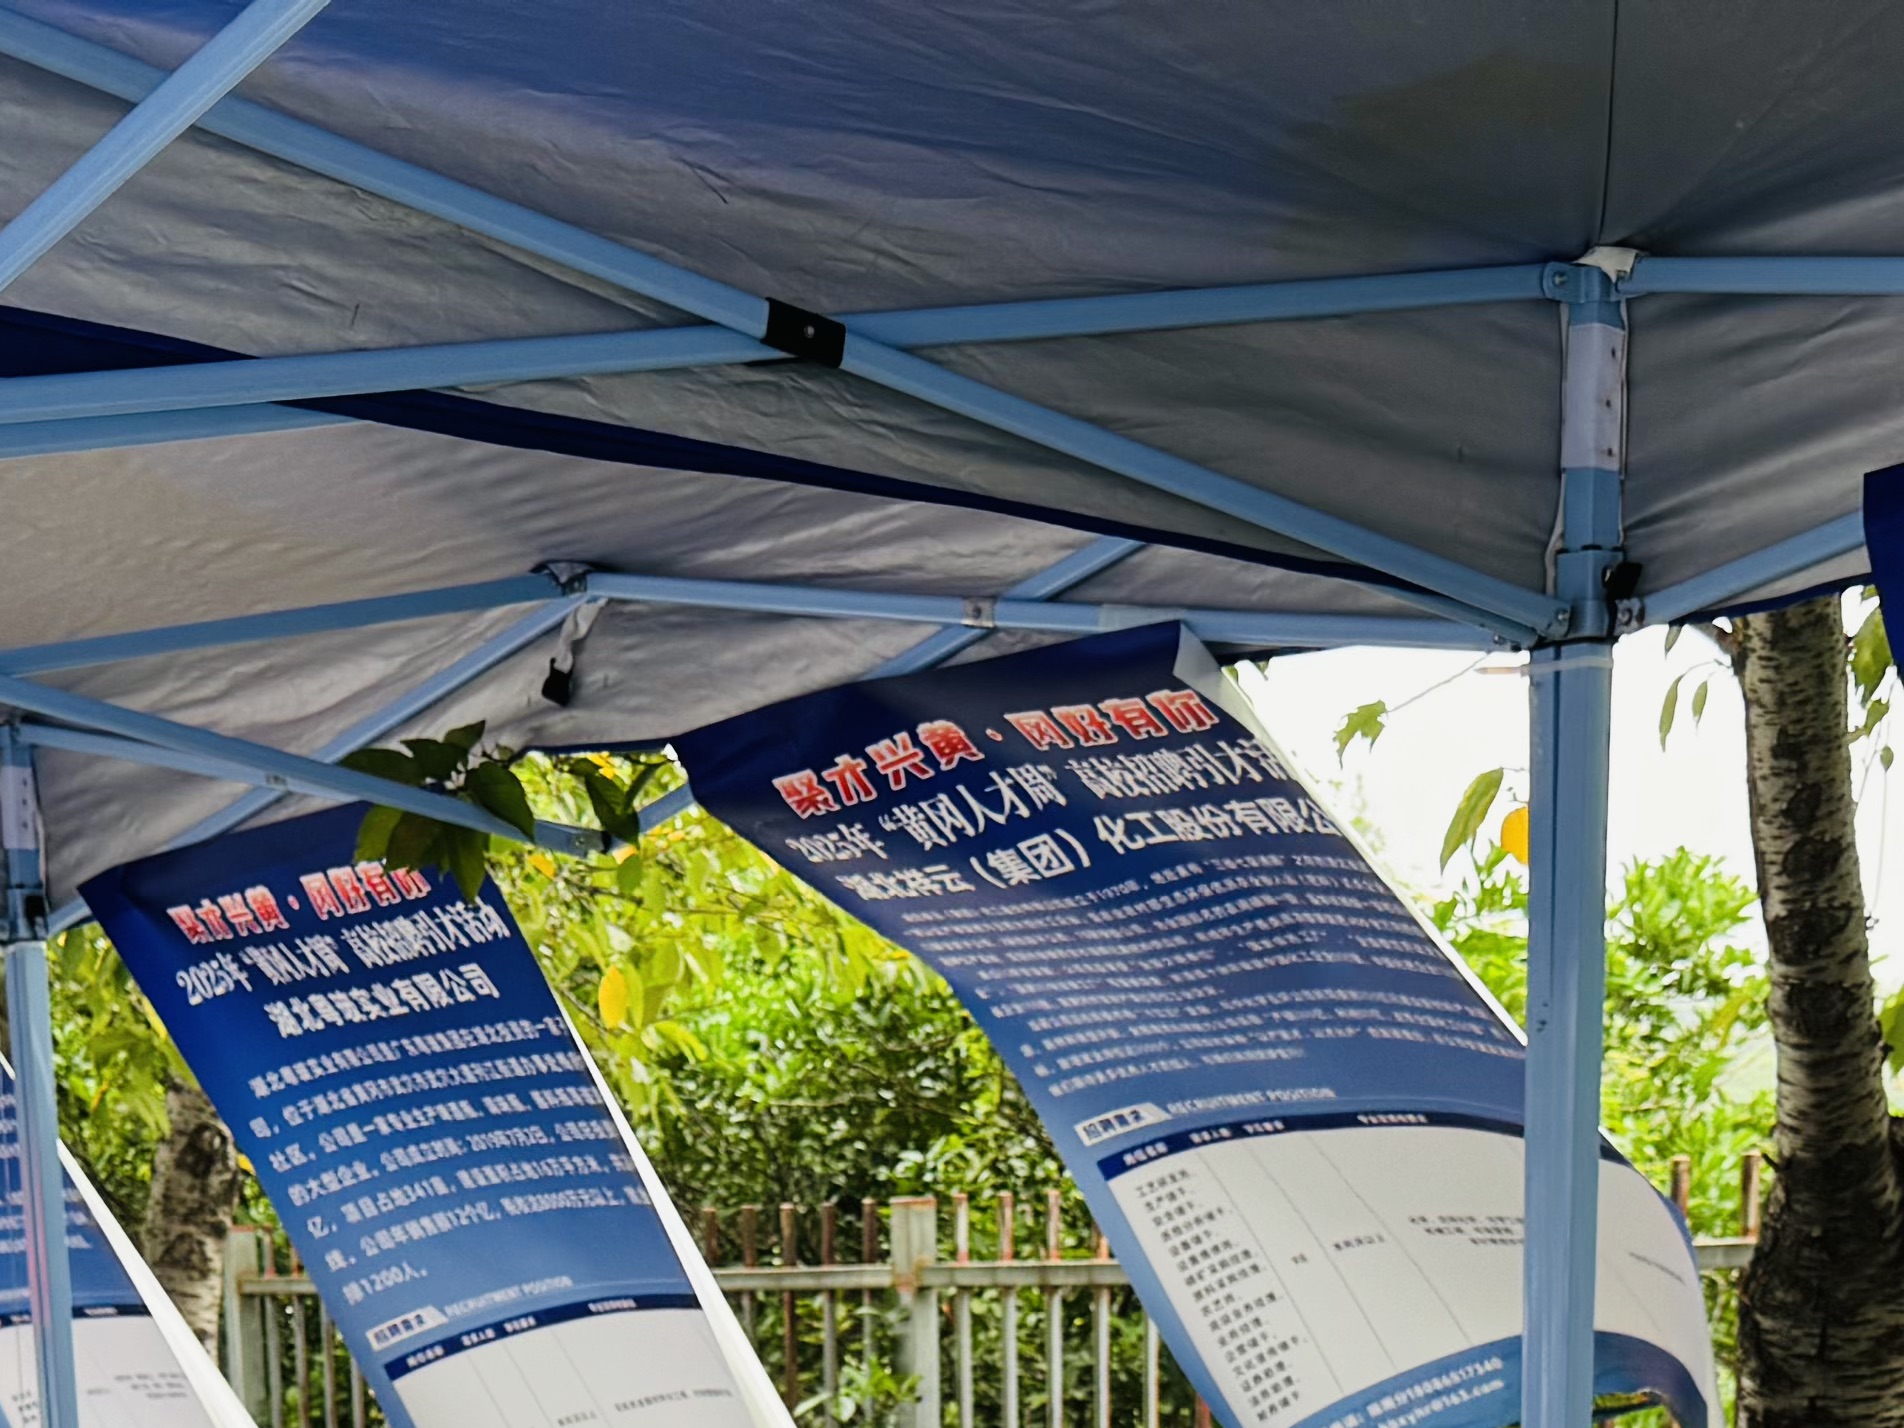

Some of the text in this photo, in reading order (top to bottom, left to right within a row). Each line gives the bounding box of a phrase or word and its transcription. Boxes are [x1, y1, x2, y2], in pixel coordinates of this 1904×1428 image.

[771, 688, 1221, 821] 聚才兴黄·冈好有你
